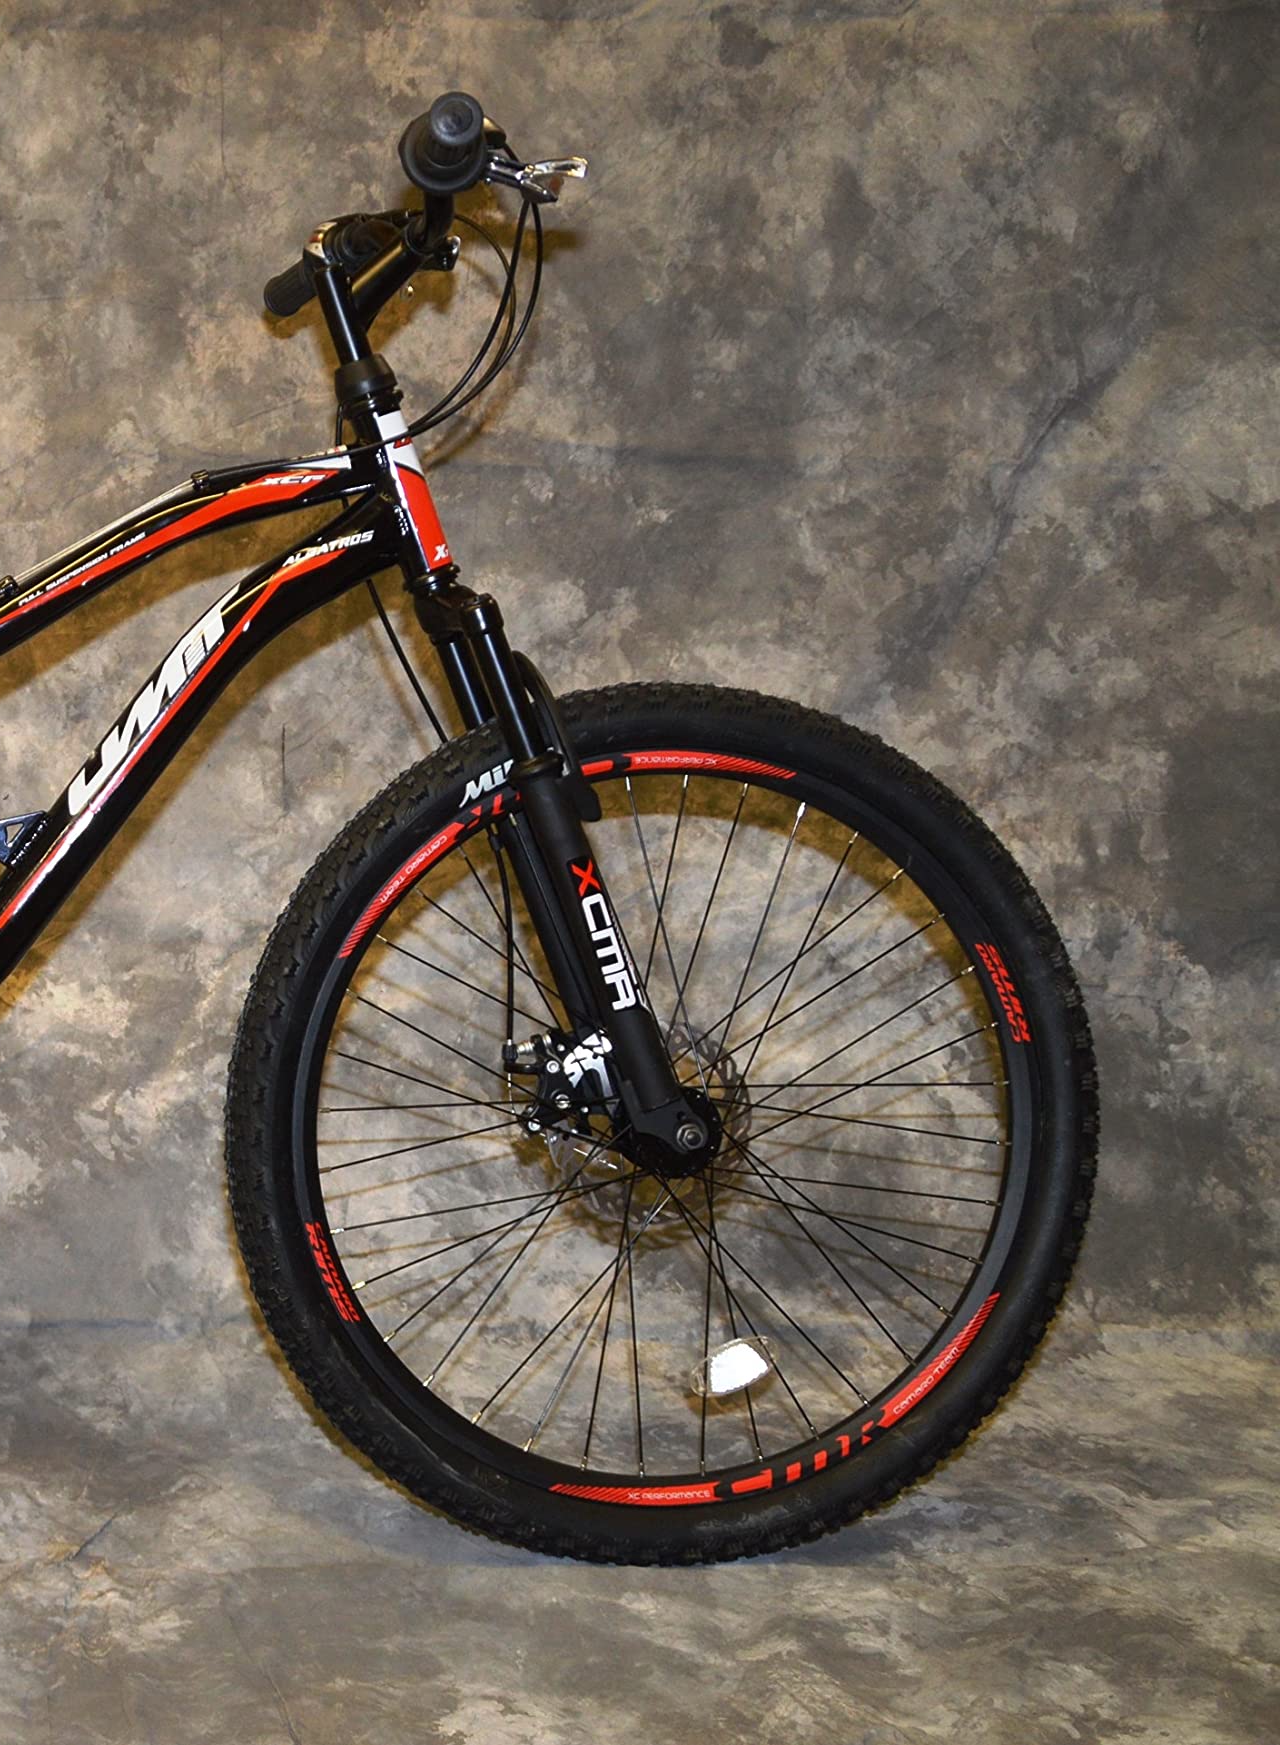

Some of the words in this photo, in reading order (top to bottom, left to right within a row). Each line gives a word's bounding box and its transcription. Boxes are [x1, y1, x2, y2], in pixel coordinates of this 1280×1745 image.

[18, 589, 44, 607] FULL
[45, 552, 109, 592] SUSPENSION
[109, 530, 146, 556] FRAME
[281, 529, 375, 568] ALBATROS
